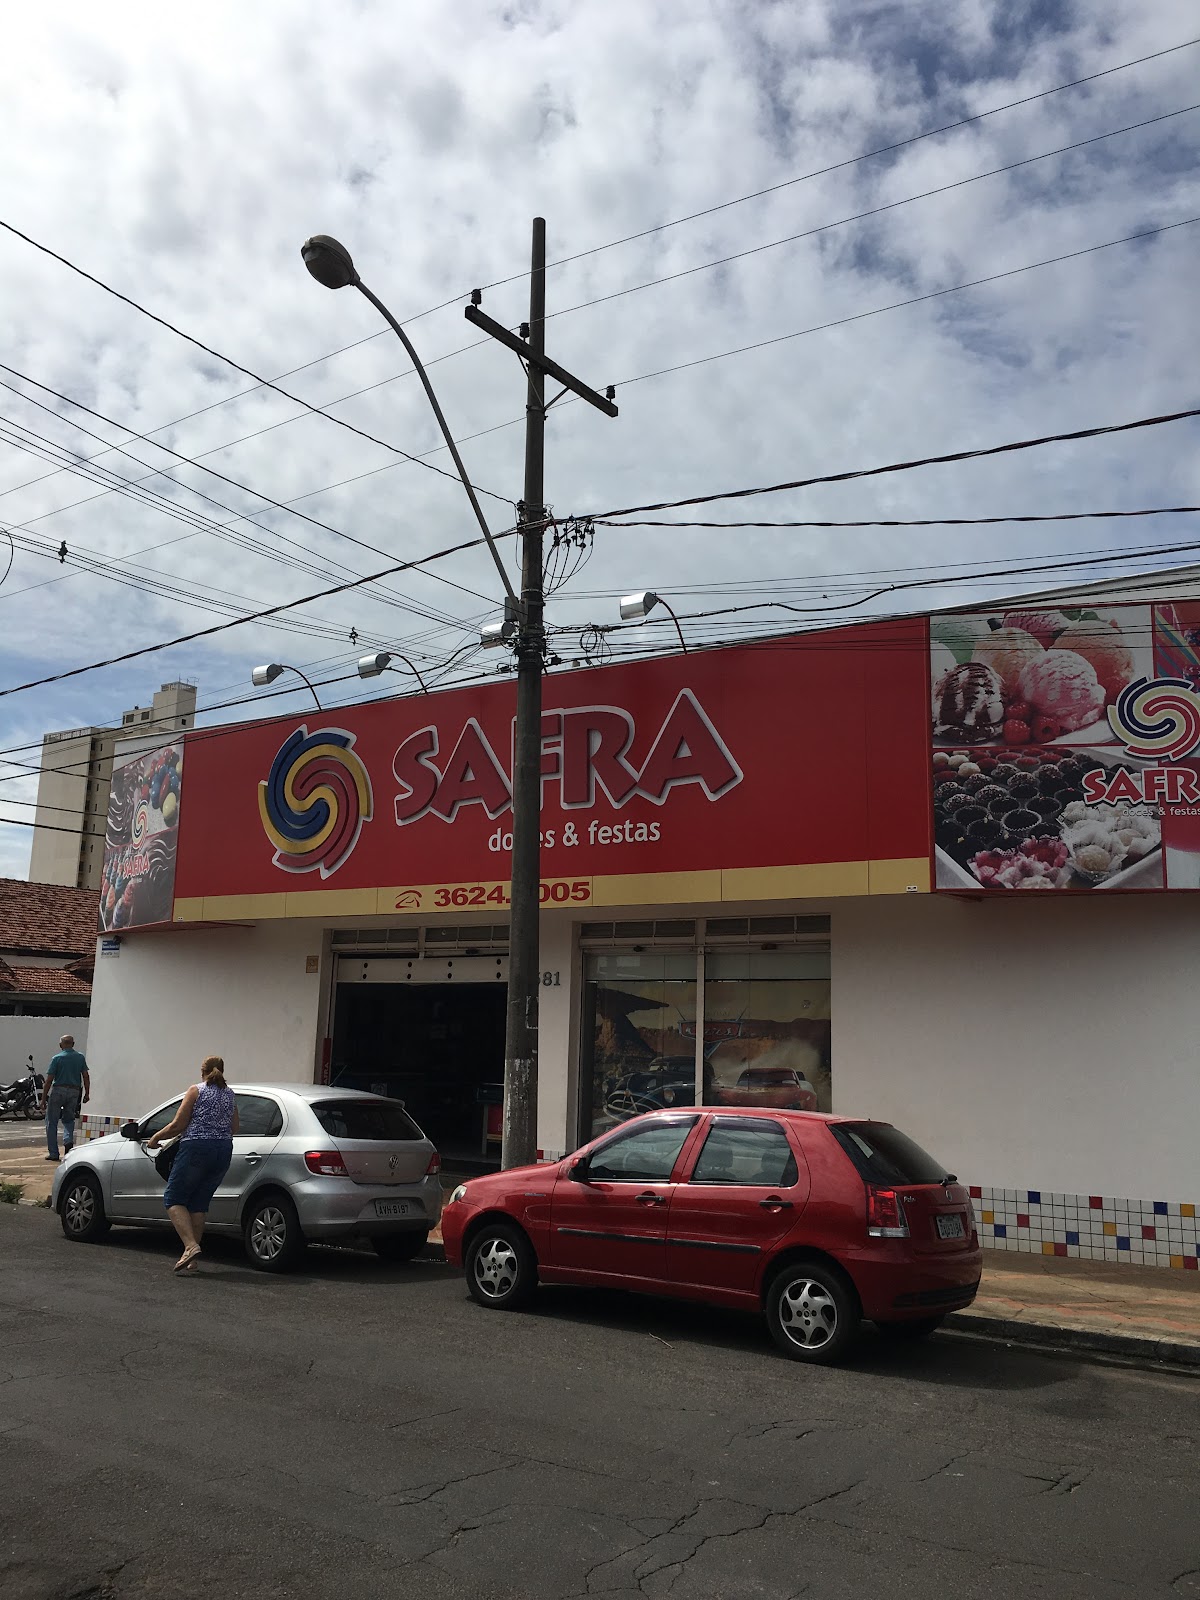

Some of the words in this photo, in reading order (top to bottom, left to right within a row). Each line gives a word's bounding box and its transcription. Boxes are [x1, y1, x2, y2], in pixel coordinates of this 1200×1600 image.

[392, 687, 744, 826] SAFRA
[1082, 767, 1200, 805] SAFR
[1122, 806, 1154, 816] doces
[1158, 806, 1166, 815] &
[488, 827, 556, 852] dos
[562, 821, 580, 847] &
[588, 819, 661, 846] festas
[434, 881, 591, 907] 3624.005
